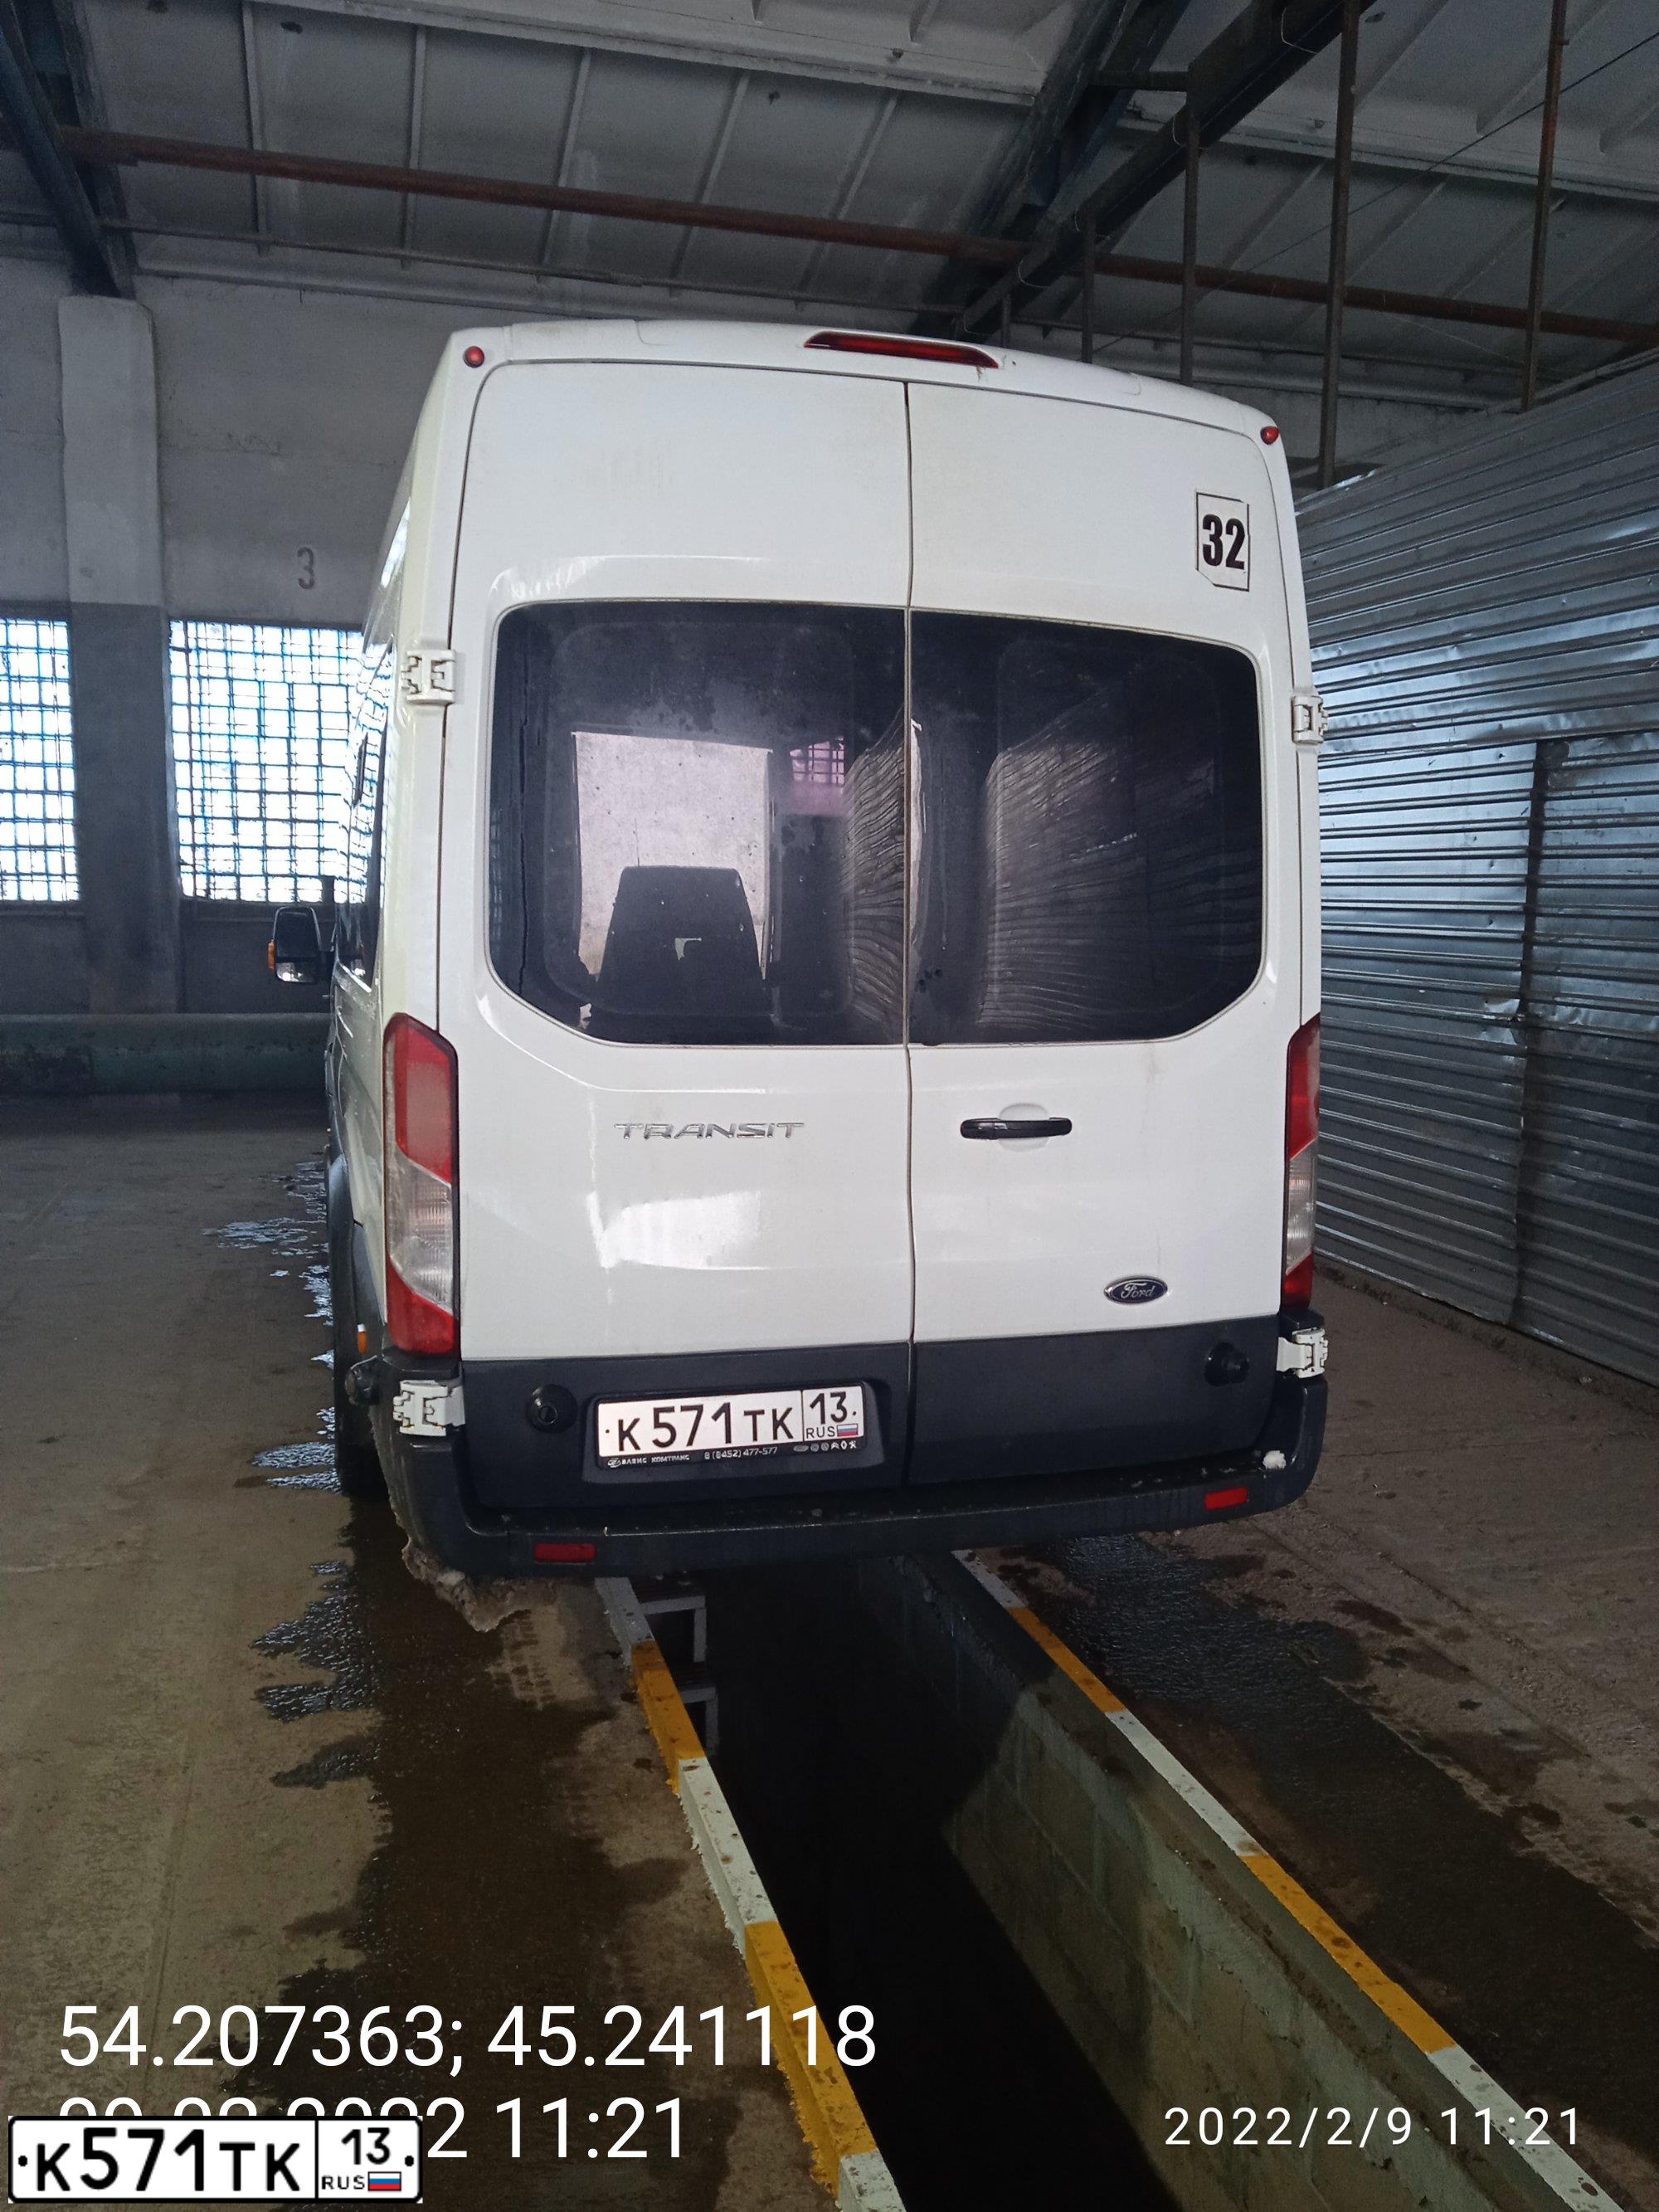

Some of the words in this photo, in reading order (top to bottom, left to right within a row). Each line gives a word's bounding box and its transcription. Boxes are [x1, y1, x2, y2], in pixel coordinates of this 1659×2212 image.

[1202, 514, 1246, 570] 32
[297, 546, 315, 589] 3
[614, 1122, 805, 1140] TRANSIT
[1120, 1282, 1155, 1298] Ford
[810, 1391, 847, 1425] 13
[805, 1425, 835, 1439] RUS
[713, 1449, 741, 1460] (8452)
[742, 1446, 778, 1457] 477-577
